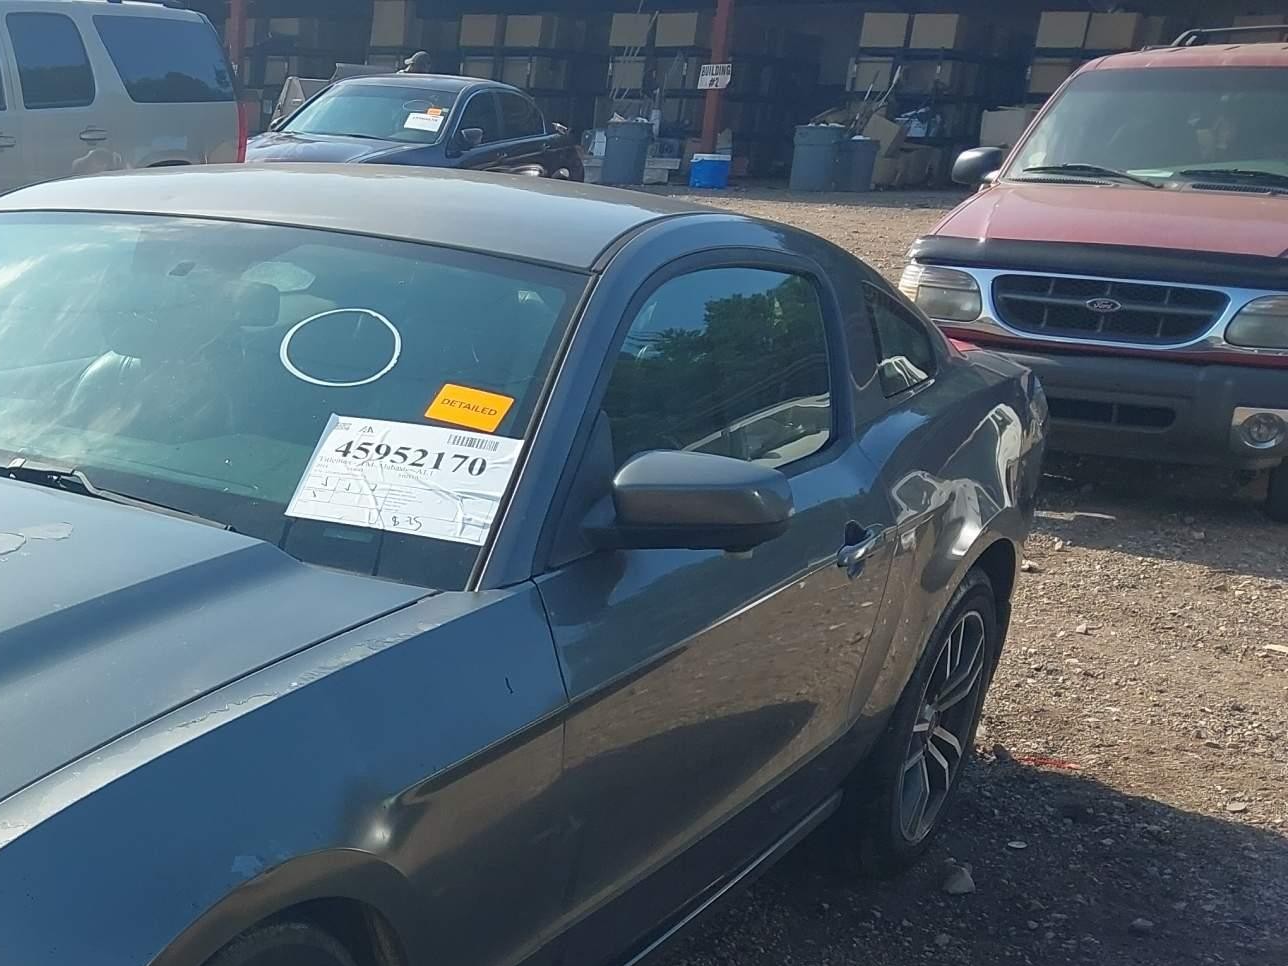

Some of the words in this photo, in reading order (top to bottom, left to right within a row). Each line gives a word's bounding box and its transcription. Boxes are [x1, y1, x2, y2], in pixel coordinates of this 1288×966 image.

[701, 65, 731, 76] BUILDING
[708, 77, 719, 88] #2
[440, 398, 497, 416] DETAILED
[335, 440, 487, 476] 45952170
